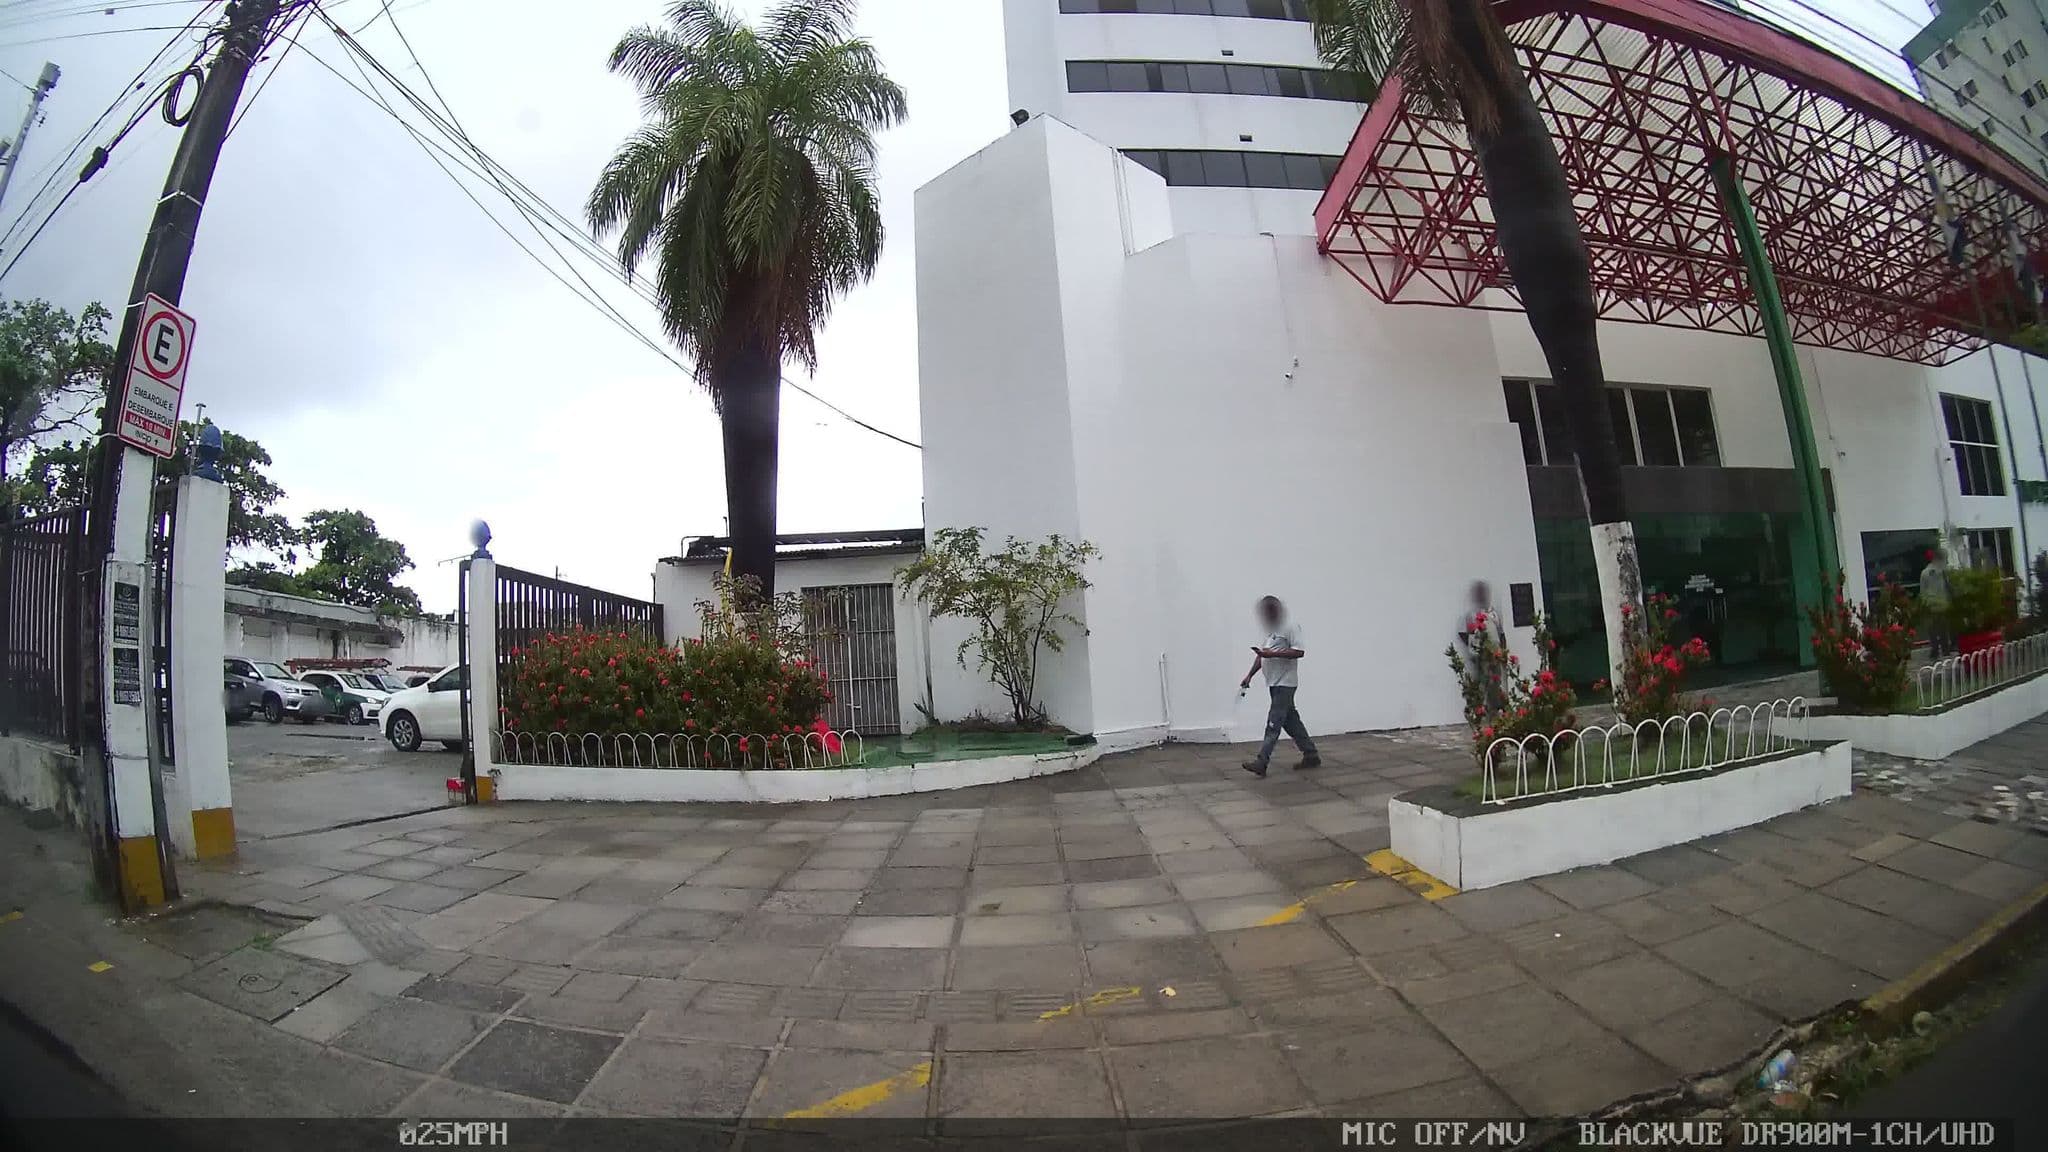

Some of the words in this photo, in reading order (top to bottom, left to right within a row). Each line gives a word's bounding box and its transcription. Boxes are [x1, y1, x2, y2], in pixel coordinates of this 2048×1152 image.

[153, 323, 174, 365] E
[134, 387, 168, 409] EMBARQUE
[168, 403, 174, 411] E
[128, 400, 173, 427] DESEMBARQUE
